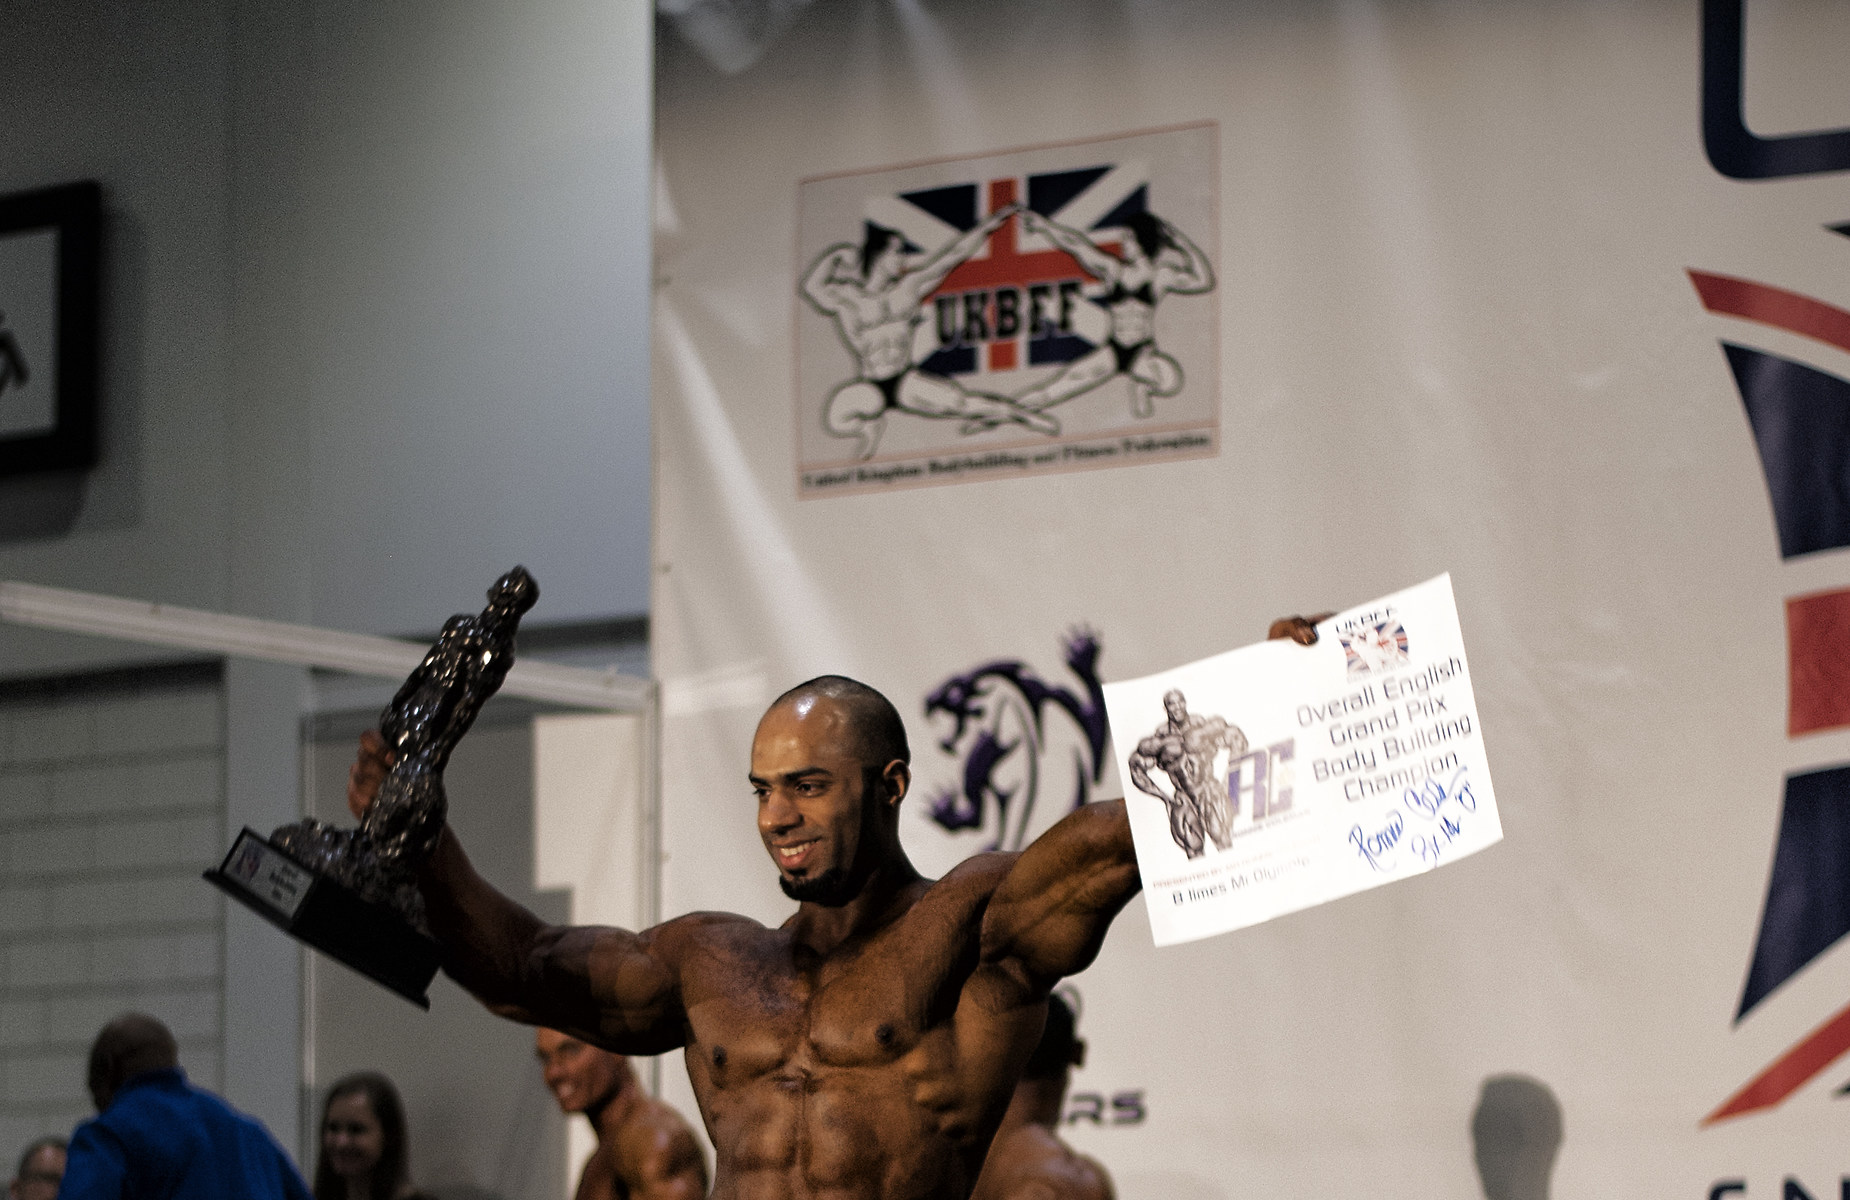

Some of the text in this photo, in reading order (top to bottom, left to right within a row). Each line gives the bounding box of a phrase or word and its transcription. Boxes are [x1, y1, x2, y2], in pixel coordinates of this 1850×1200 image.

[1297, 685, 1376, 728] Overall
[1383, 655, 1463, 700] English
[1329, 695, 1448, 747] Grand Prix
[1312, 714, 1472, 782] Body Building
[1343, 752, 1459, 802] Champion
